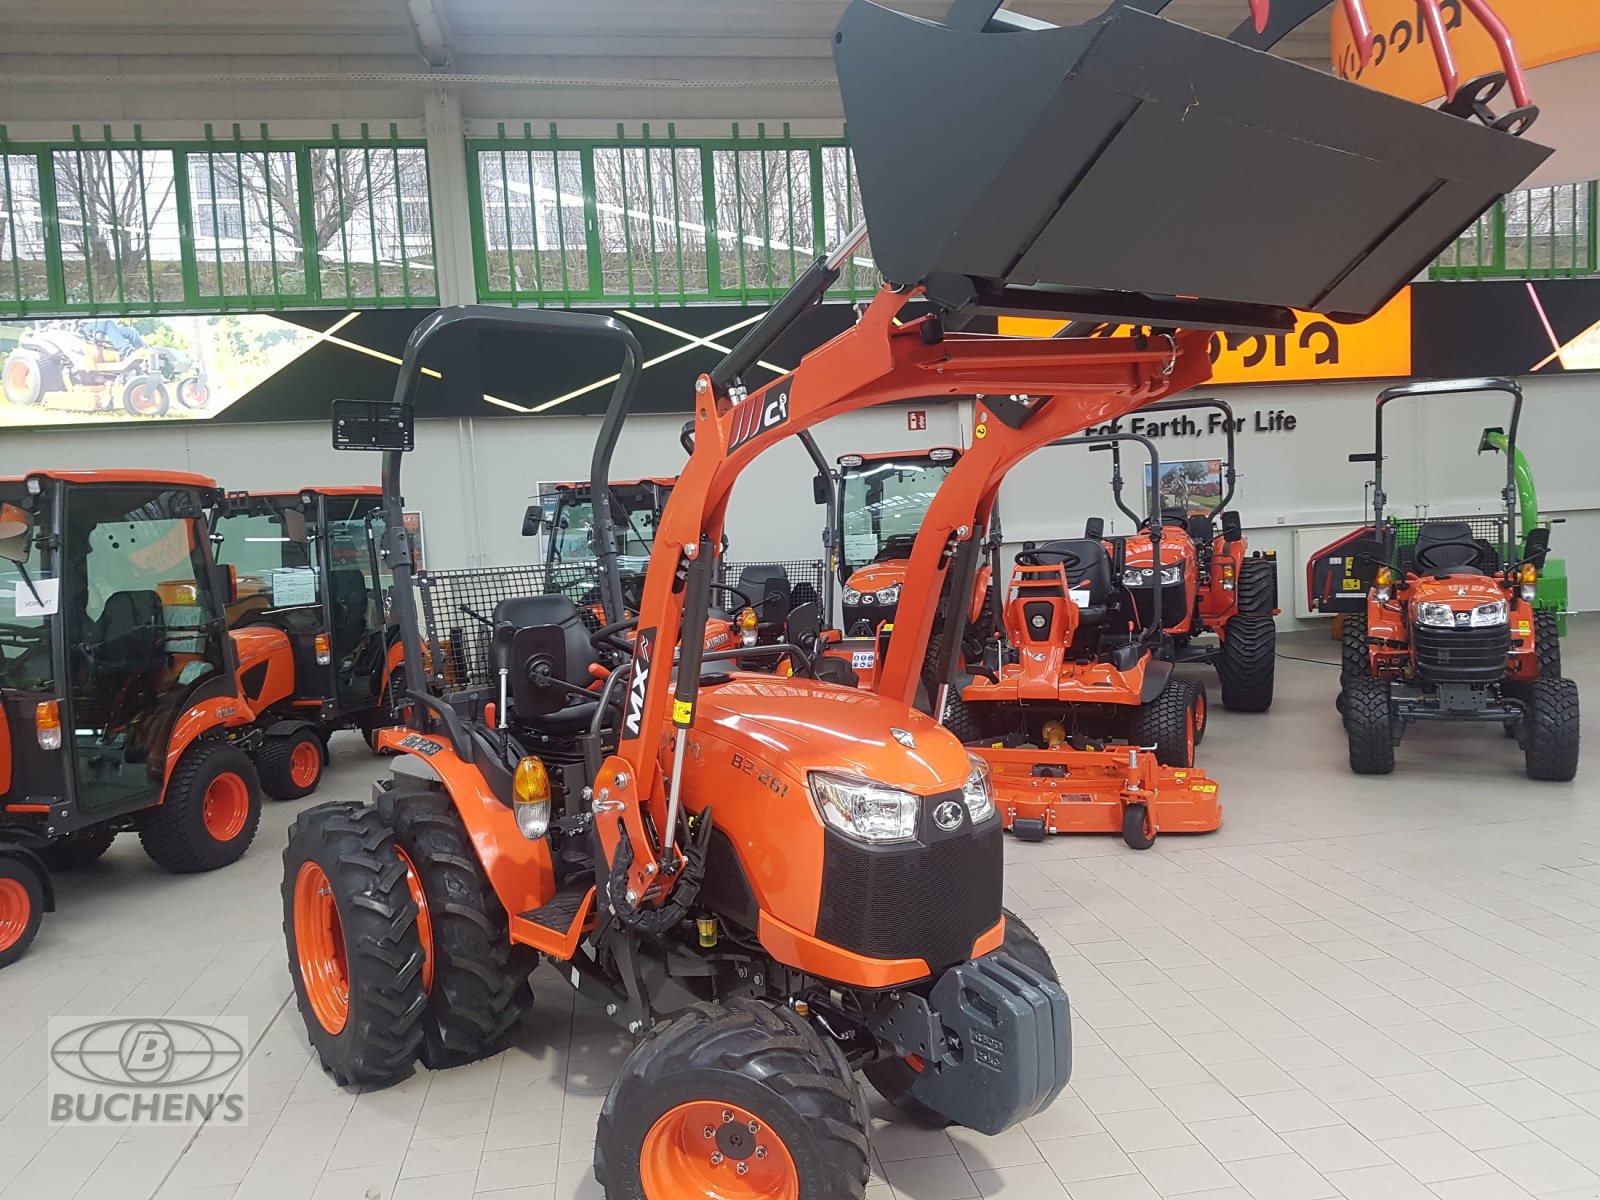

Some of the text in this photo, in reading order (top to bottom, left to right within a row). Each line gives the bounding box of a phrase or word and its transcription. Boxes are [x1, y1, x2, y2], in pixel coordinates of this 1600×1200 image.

[1131, 415, 1203, 437] Earth,
[1255, 410, 1297, 432] Life
[626, 658, 649, 735] MX
[731, 752, 789, 798] B2-261
